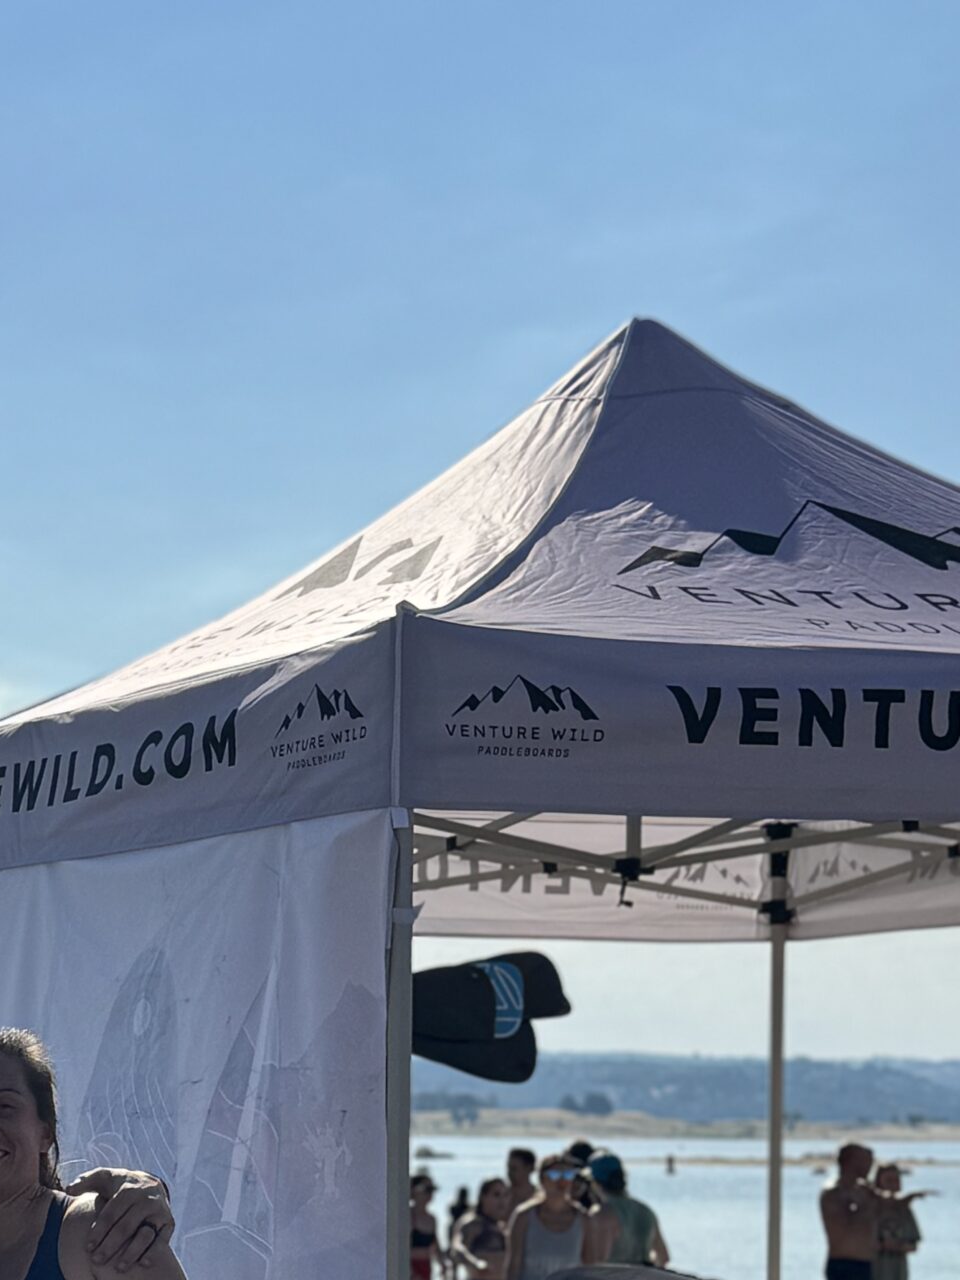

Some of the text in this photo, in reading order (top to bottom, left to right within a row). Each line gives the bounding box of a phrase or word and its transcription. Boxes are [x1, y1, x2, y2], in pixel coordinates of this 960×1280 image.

[666, 685, 960, 751] VENTU
[270, 726, 368, 758] VENTURE WILD
[445, 723, 604, 743] VENTURE WILD
[477, 745, 570, 759] PADDLEBOARDS
